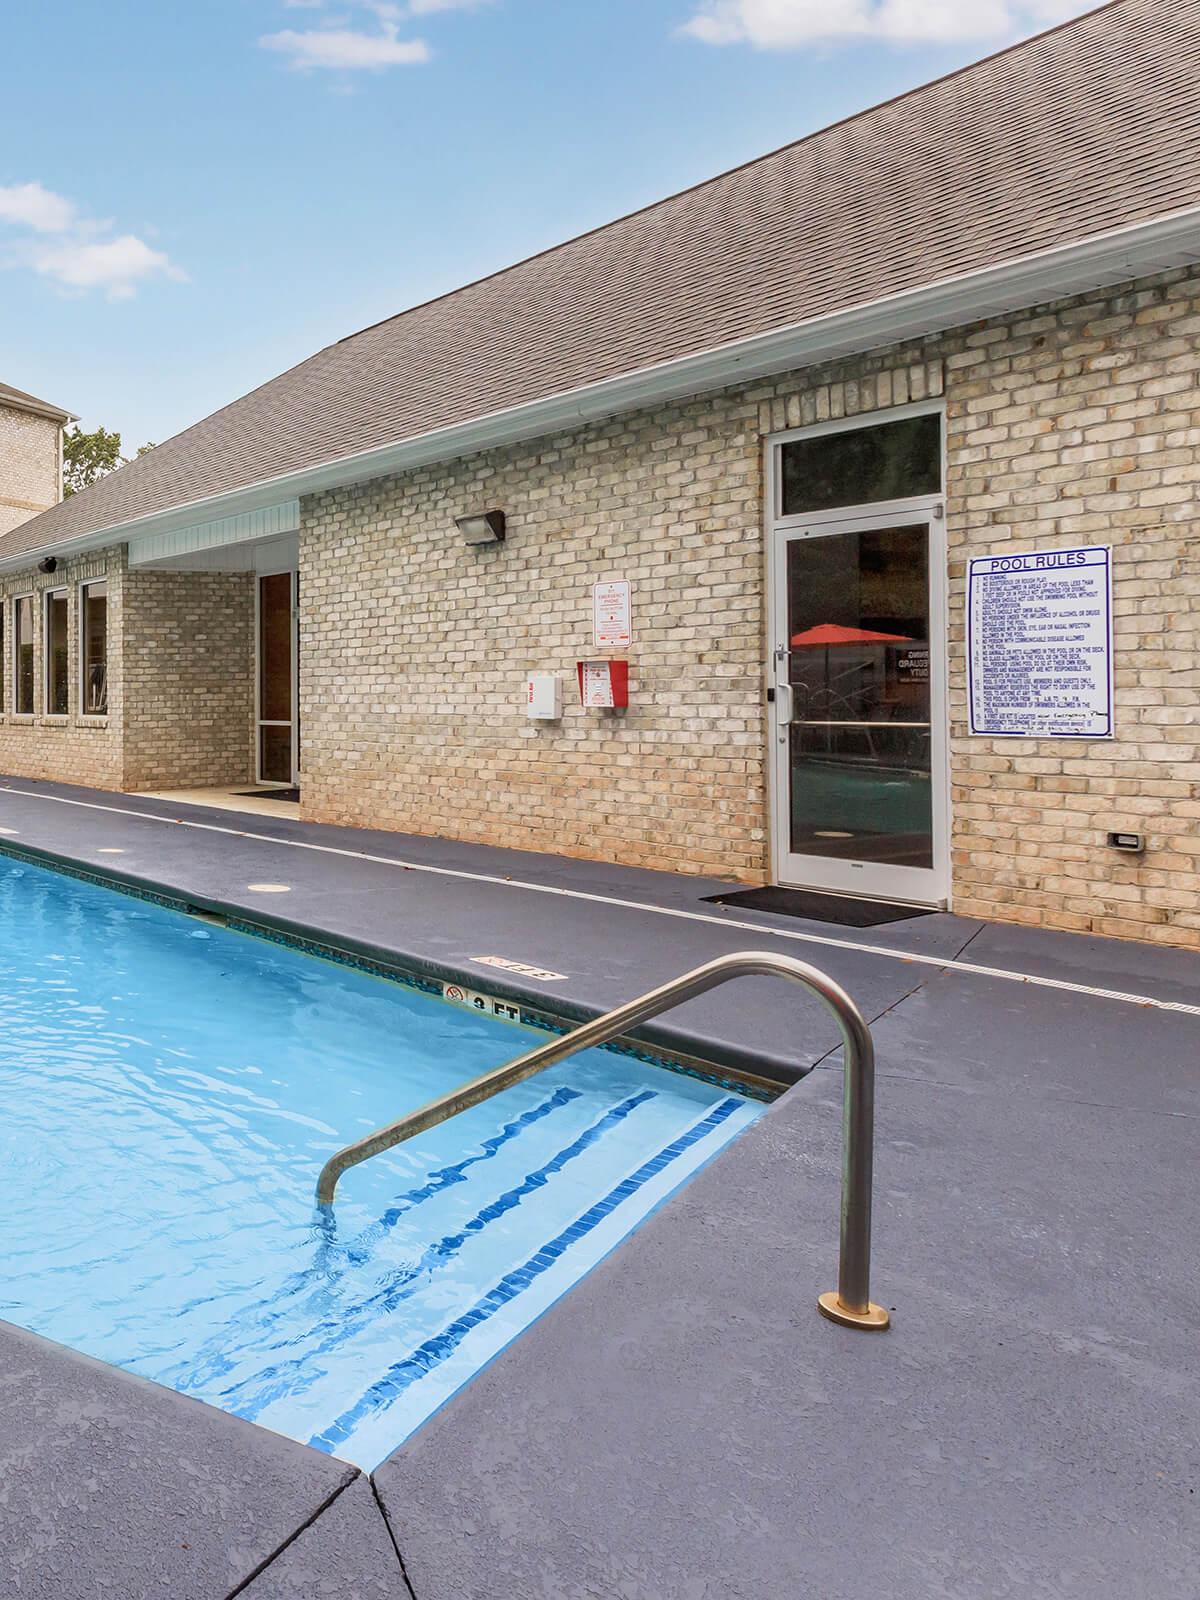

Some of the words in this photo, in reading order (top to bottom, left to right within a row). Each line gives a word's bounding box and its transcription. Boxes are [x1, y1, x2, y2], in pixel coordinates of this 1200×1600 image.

[991, 557, 1030, 571] POOL
[1036, 552, 1085, 567] RULES
[494, 1002, 518, 1019] FT
